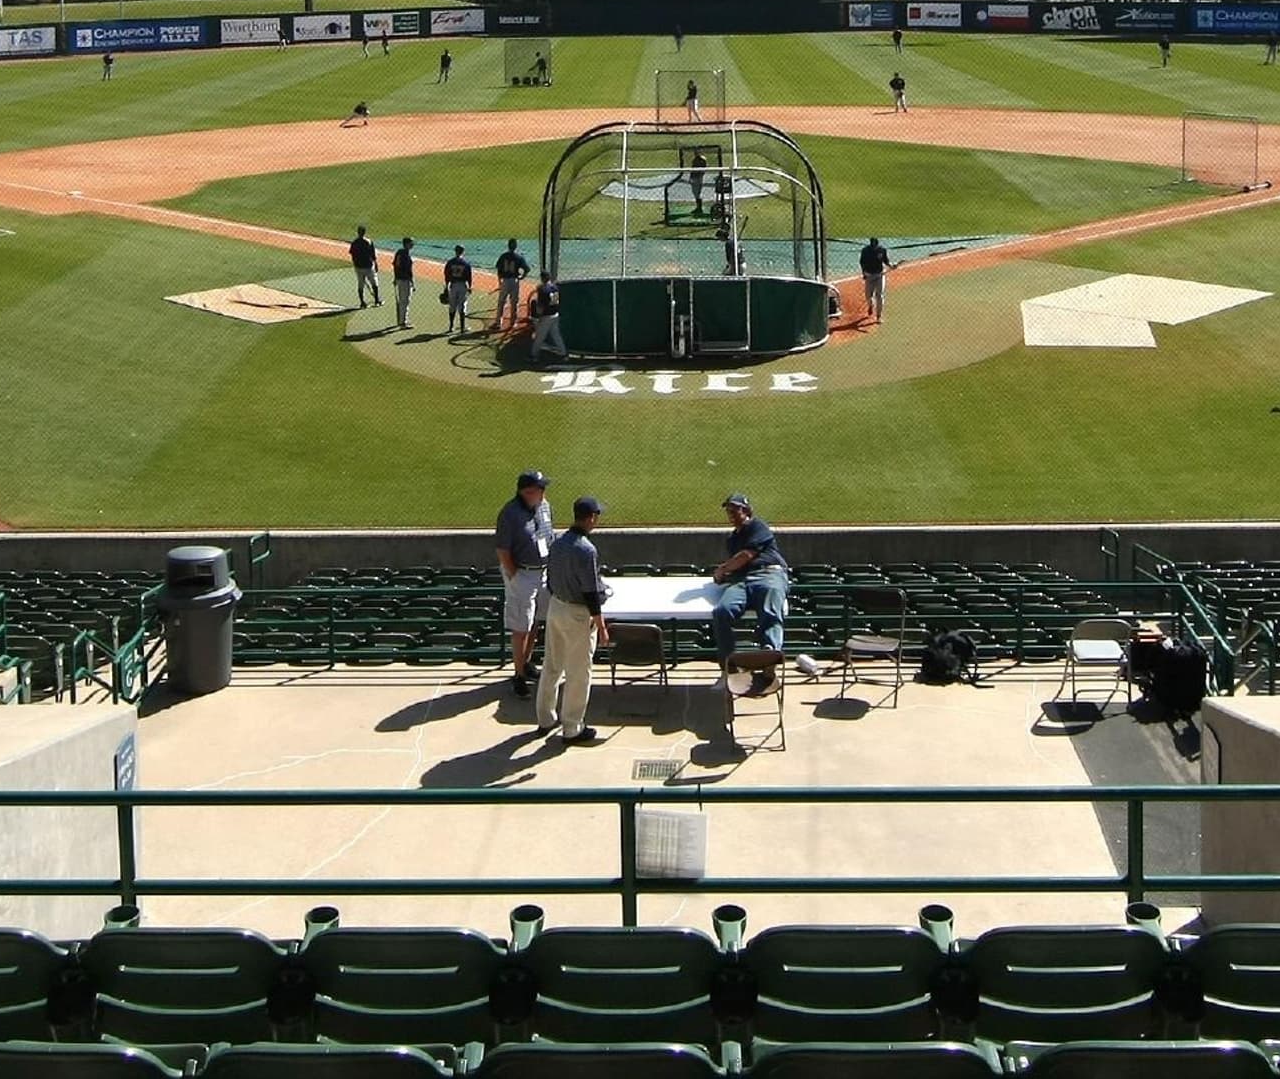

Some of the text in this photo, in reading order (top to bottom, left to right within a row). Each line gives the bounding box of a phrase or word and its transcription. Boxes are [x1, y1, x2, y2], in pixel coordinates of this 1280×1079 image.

[1042, 5, 1097, 25] chron
[159, 26, 200, 34] POWER
[8, 30, 44, 46] TAS
[160, 34, 200, 43] ALLEY
